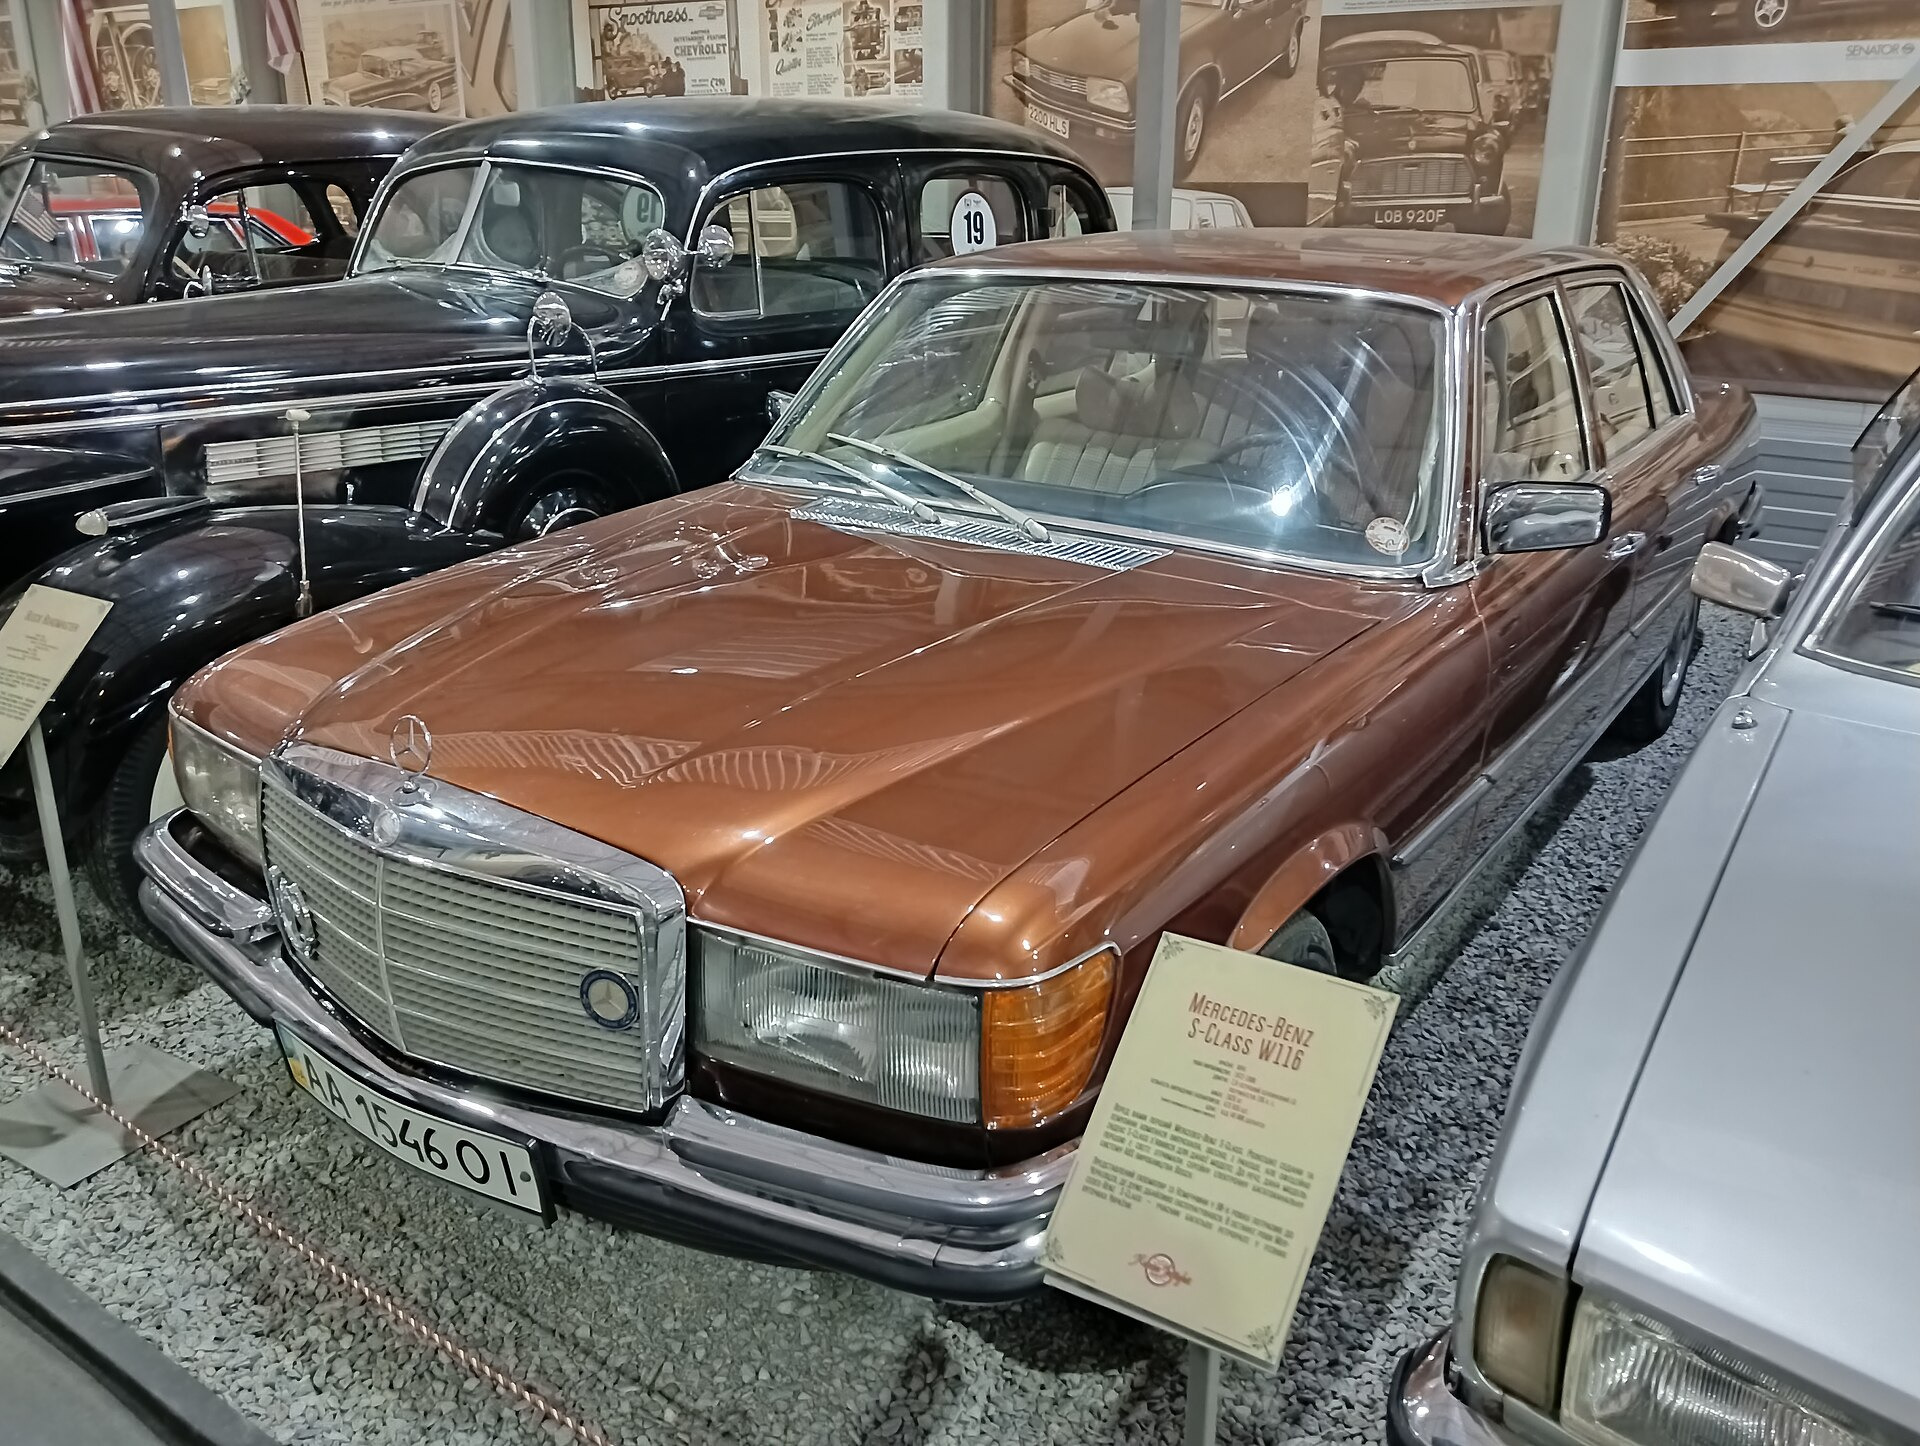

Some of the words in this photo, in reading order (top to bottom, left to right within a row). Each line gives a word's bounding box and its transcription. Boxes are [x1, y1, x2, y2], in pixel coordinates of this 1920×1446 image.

[673, 43, 727, 57] CHEVROLET
[1845, 43, 1900, 56] SENATOR
[1029, 107, 1048, 126] 2200
[1049, 114, 1067, 135] HLS
[963, 210, 985, 245] 19
[1374, 210, 1403, 223] LOB
[1406, 209, 1446, 223] 920F
[1258, 1038, 1305, 1071] W116
[303, 1053, 350, 1119] AA
[355, 1094, 449, 1171] 1546
